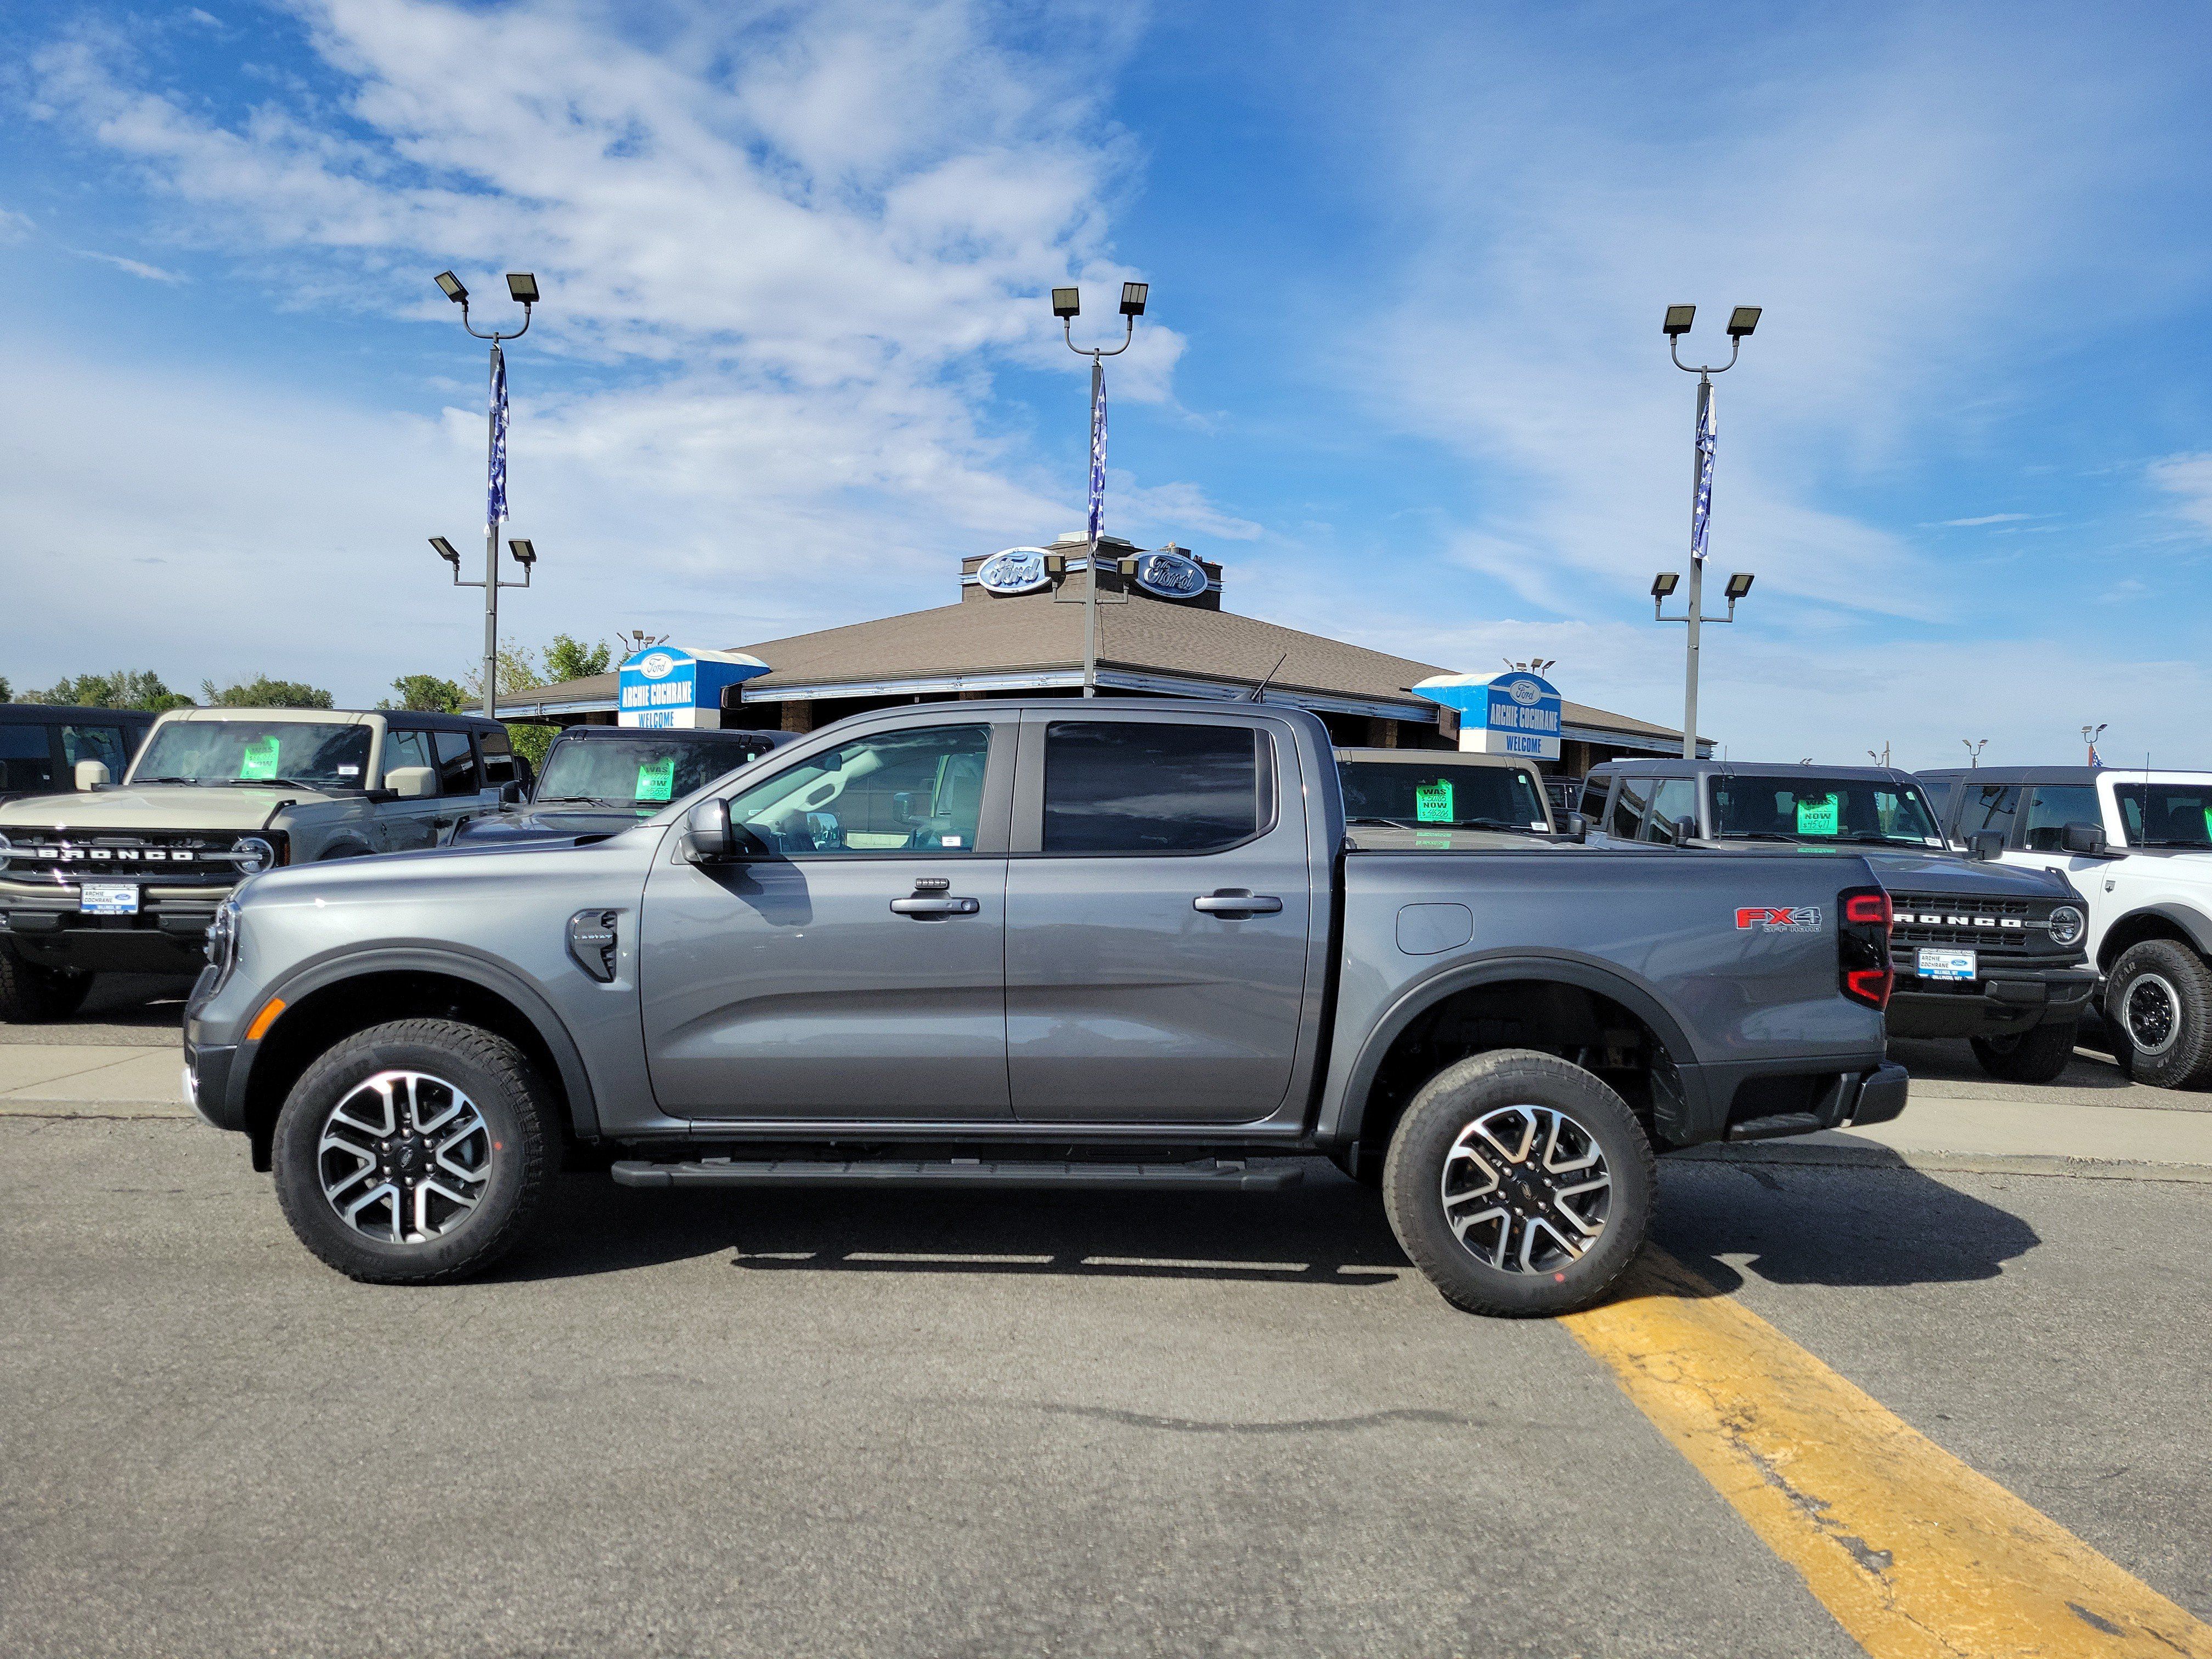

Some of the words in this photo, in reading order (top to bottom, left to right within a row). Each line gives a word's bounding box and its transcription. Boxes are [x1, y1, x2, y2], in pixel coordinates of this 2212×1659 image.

[989, 553, 1040, 585] Ford
[1144, 556, 1195, 590] Ford
[647, 658, 666, 673] Ford
[622, 685, 649, 708] ARCHIE
[651, 681, 692, 705] COCHRANE
[1516, 684, 1535, 700] Ford
[639, 712, 674, 728] WELCOME
[1490, 703, 1518, 727] ARCHIE
[1520, 707, 1558, 731] COCHRANE
[1506, 735, 1542, 753] WELCOME
[38, 849, 193, 860] BRONCO
[1736, 907, 1822, 929] FX4
[1893, 913, 2021, 928] RONCO
